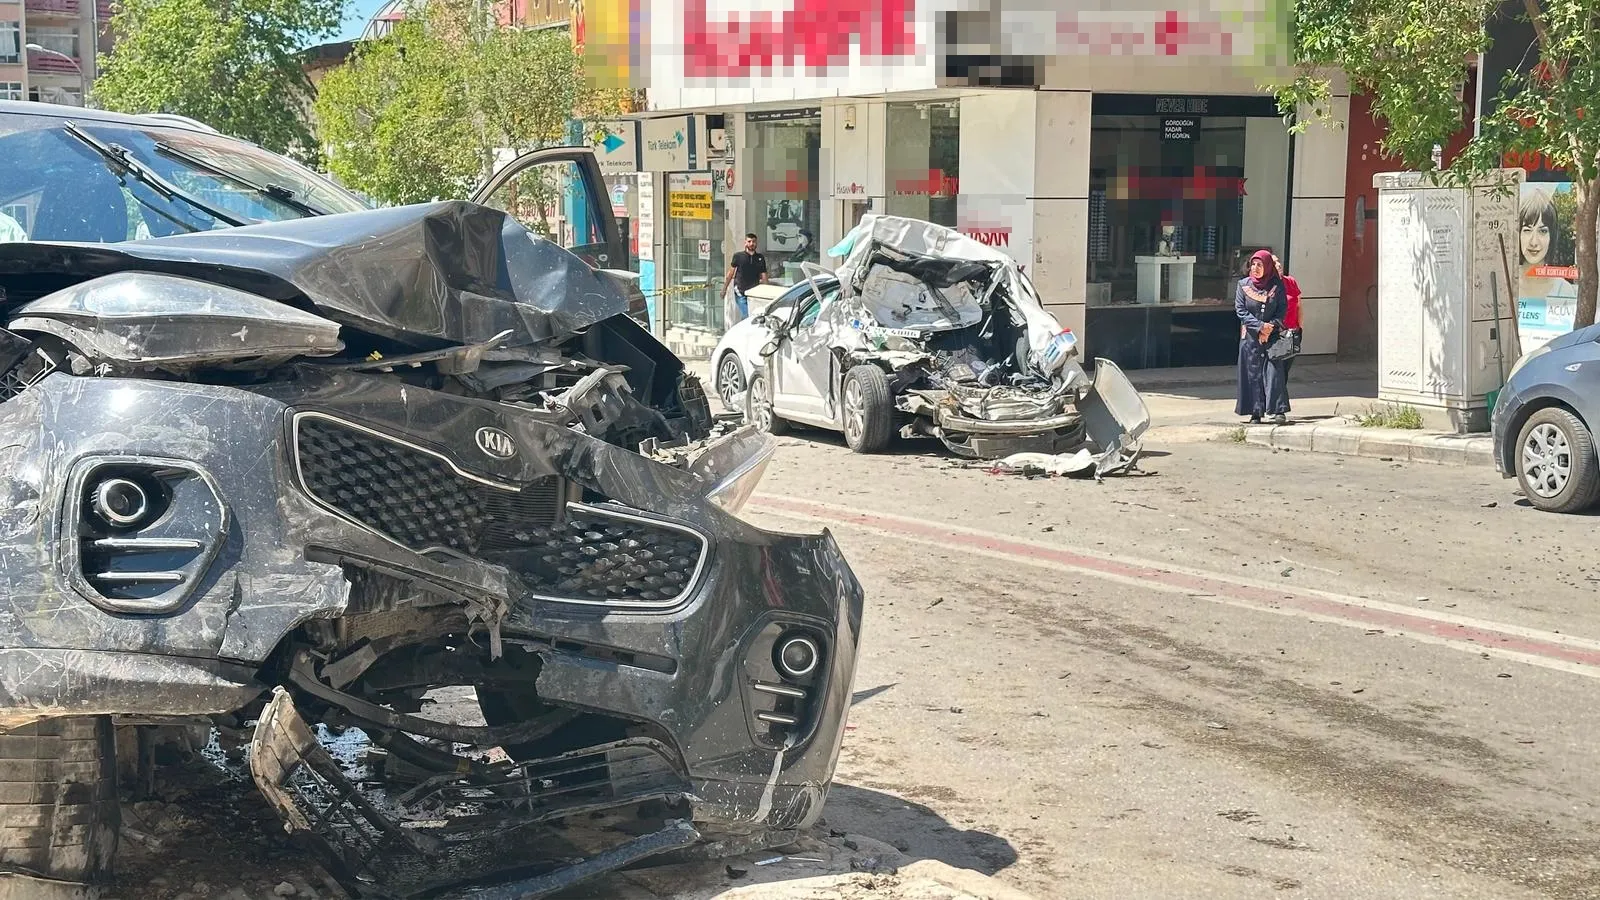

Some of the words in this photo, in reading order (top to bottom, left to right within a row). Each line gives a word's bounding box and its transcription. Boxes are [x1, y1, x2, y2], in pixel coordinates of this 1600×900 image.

[1155, 98, 1185, 113] NEVER
[1522, 311, 1540, 320] LENS
[483, 430, 513, 456] KIA
